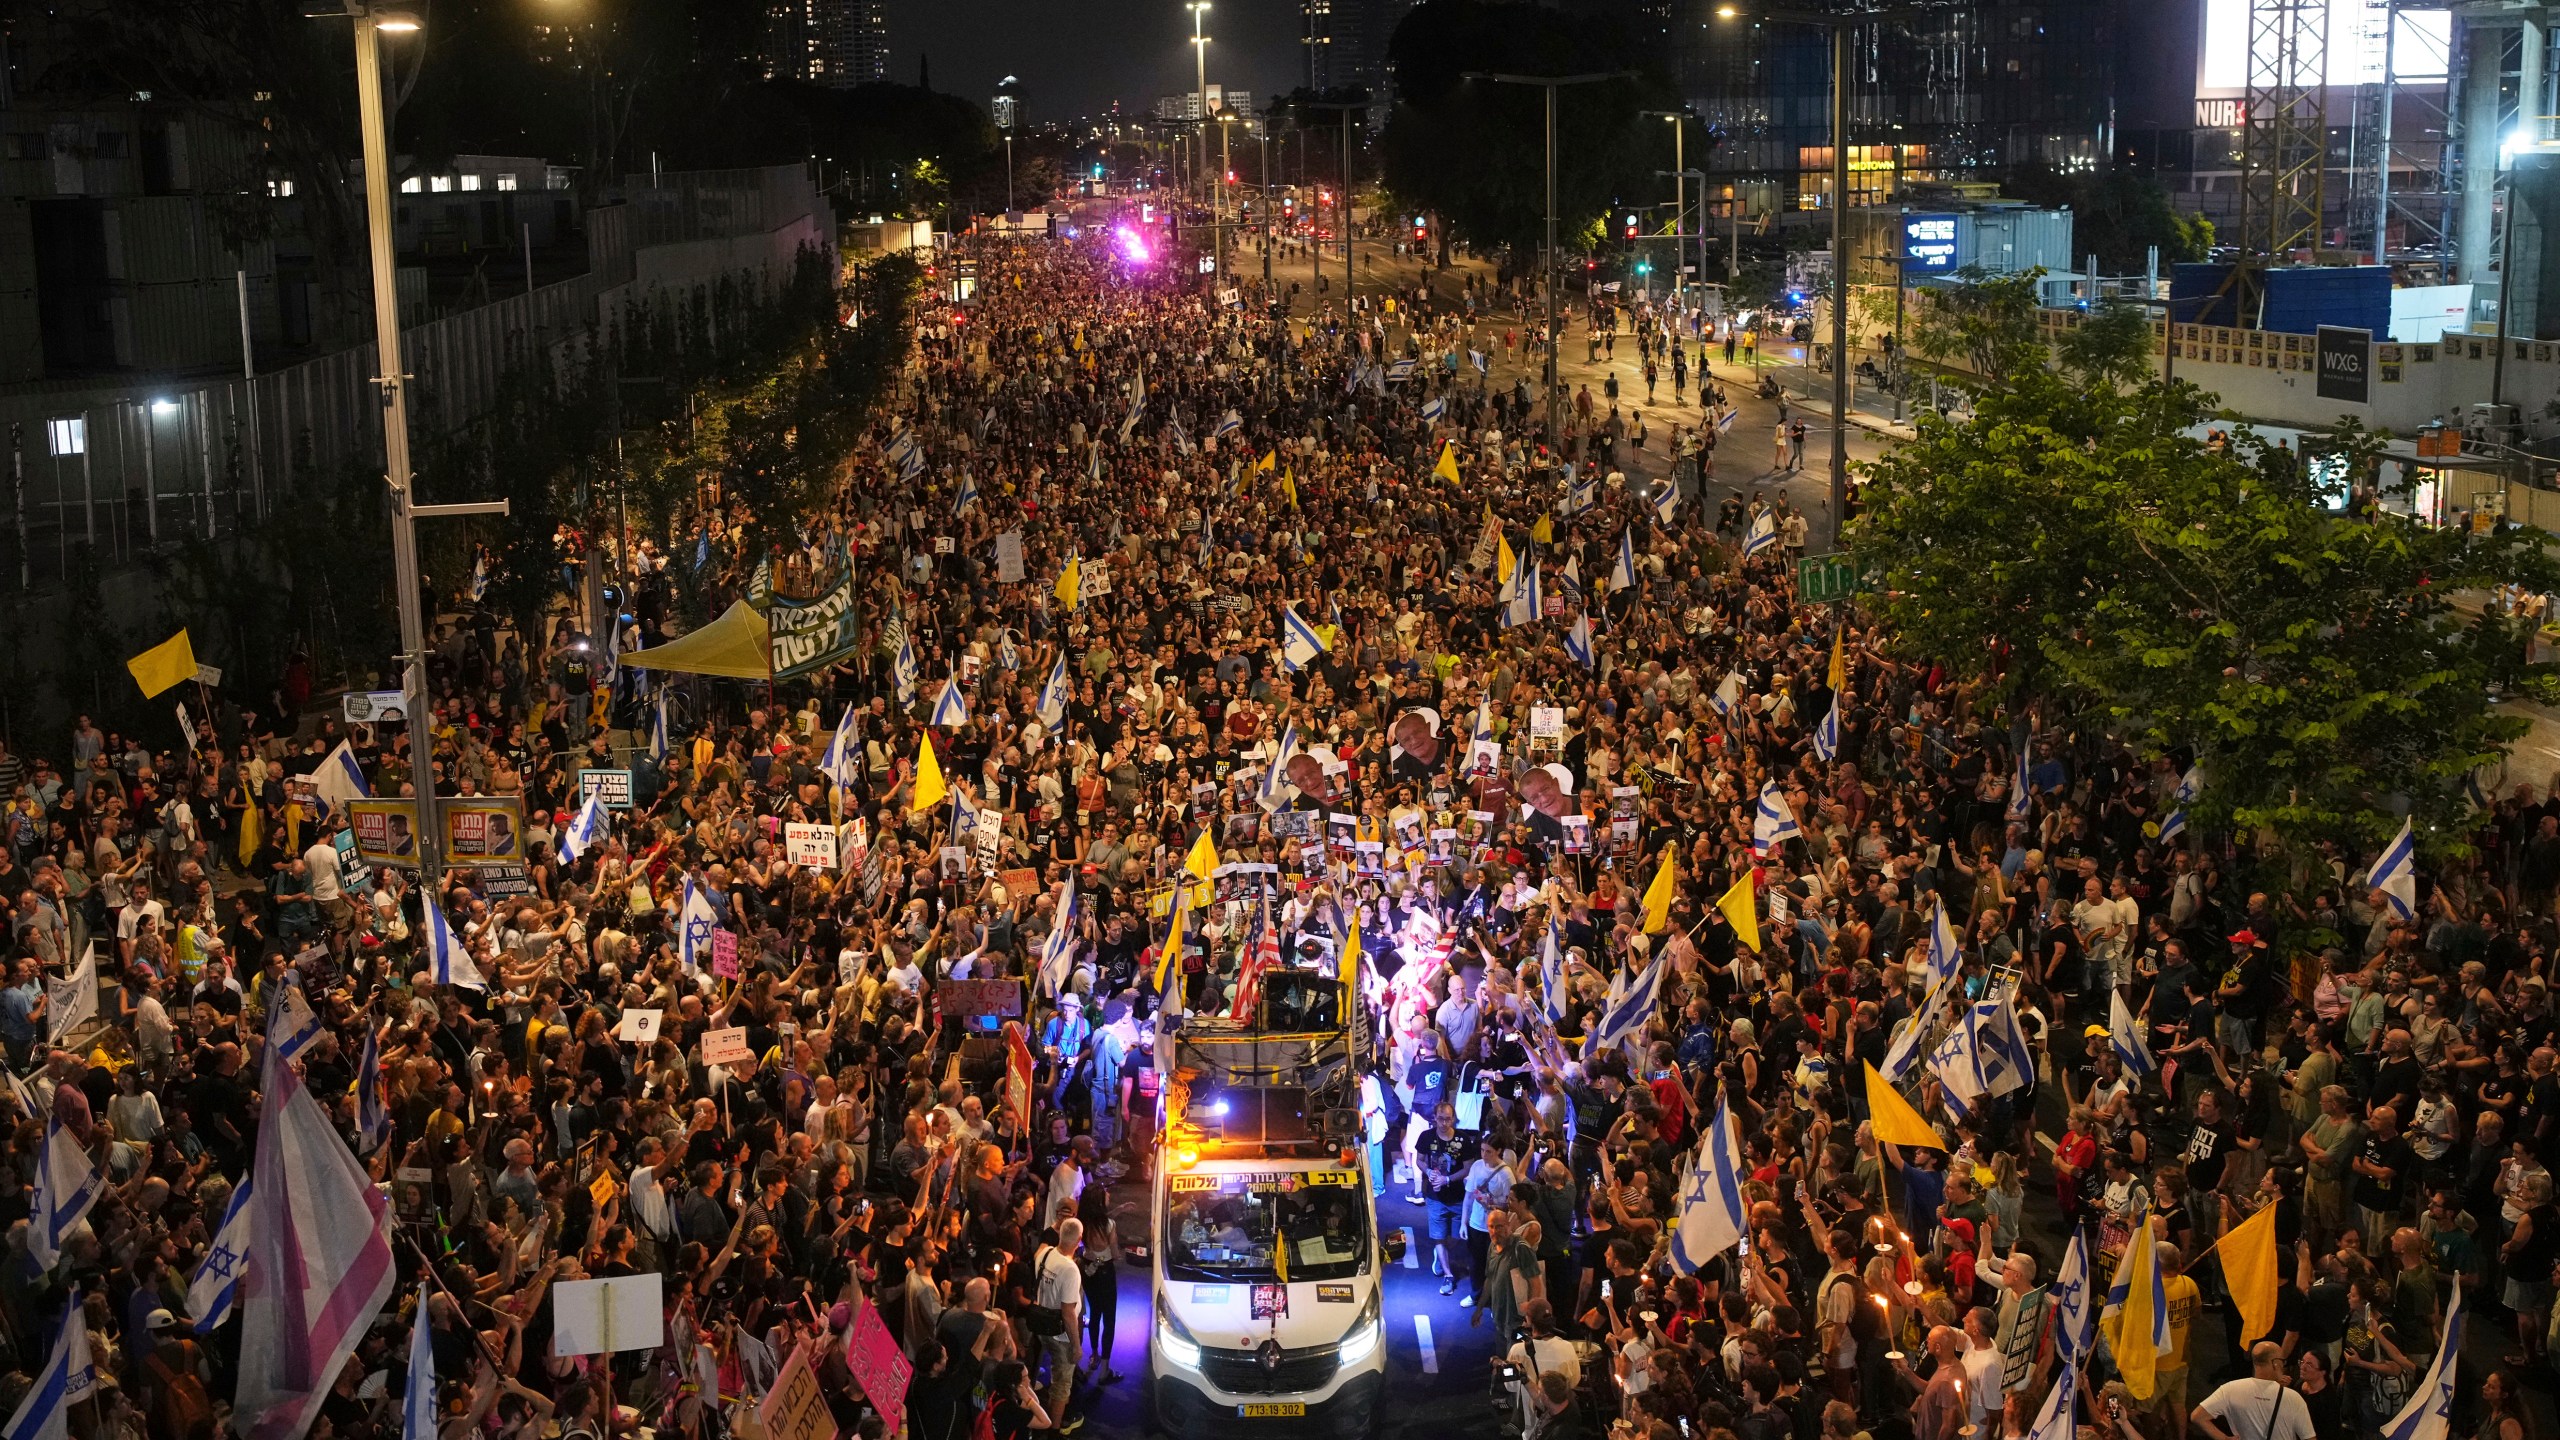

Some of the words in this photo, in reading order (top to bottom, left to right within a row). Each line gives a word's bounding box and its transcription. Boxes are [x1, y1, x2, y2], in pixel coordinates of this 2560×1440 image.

[1848, 160, 1895, 171] MIDTOWN
[584, 773, 601, 783] את
[602, 774, 627, 784] עצרו
[362, 814, 384, 829] מתן
[460, 814, 482, 829] מתן
[454, 829, 483, 839] אנגרסט
[811, 827, 822, 840] לא
[824, 832, 835, 841] זה
[804, 844, 816, 853] זה
[483, 868, 502, 878] END
[505, 867, 523, 877] THE
[486, 879, 527, 894] BLOODSHED
[722, 1034, 742, 1043] סדום
[1176, 1176, 1218, 1189] מלווה
[1254, 1173, 1275, 1183] בדרך
[1318, 1173, 1348, 1184] רכב
[2021, 1305, 2038, 1322] HOW
